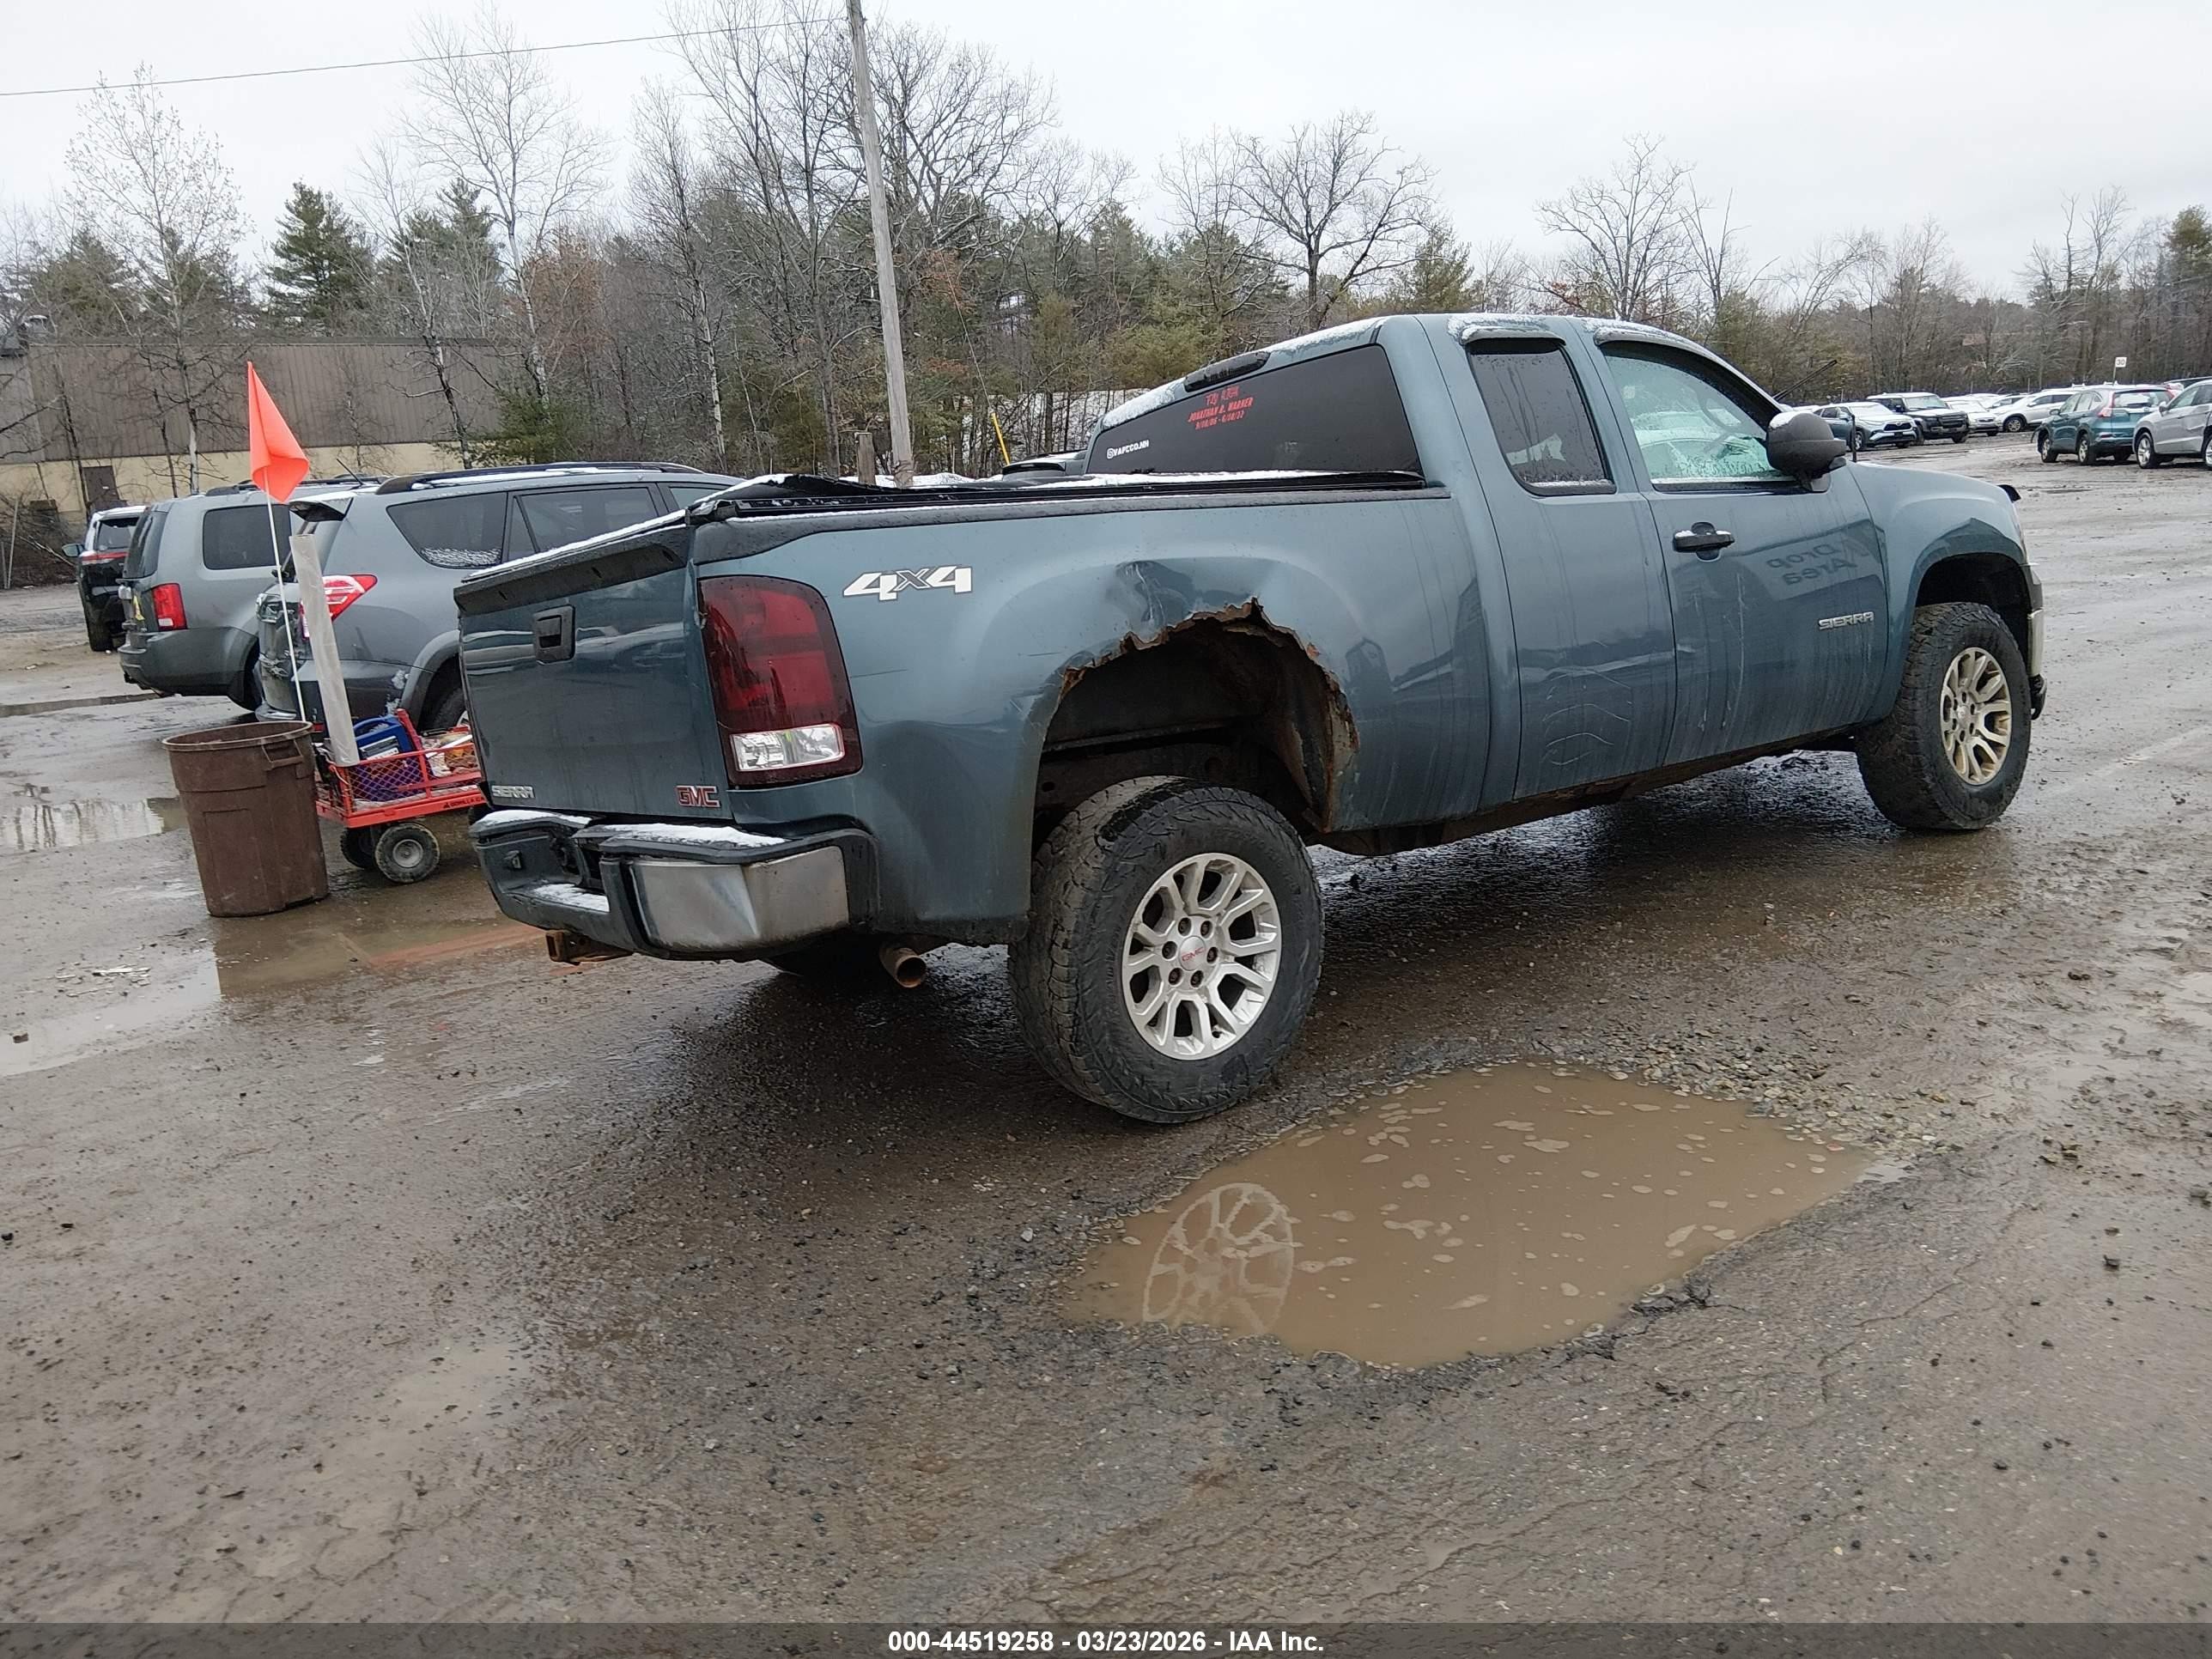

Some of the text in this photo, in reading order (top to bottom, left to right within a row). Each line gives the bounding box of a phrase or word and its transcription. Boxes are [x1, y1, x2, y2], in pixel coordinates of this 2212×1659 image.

[1819, 611, 1875, 630] SIERRA
[675, 785, 720, 808] GMC
[1181, 945, 1205, 962] GMC
